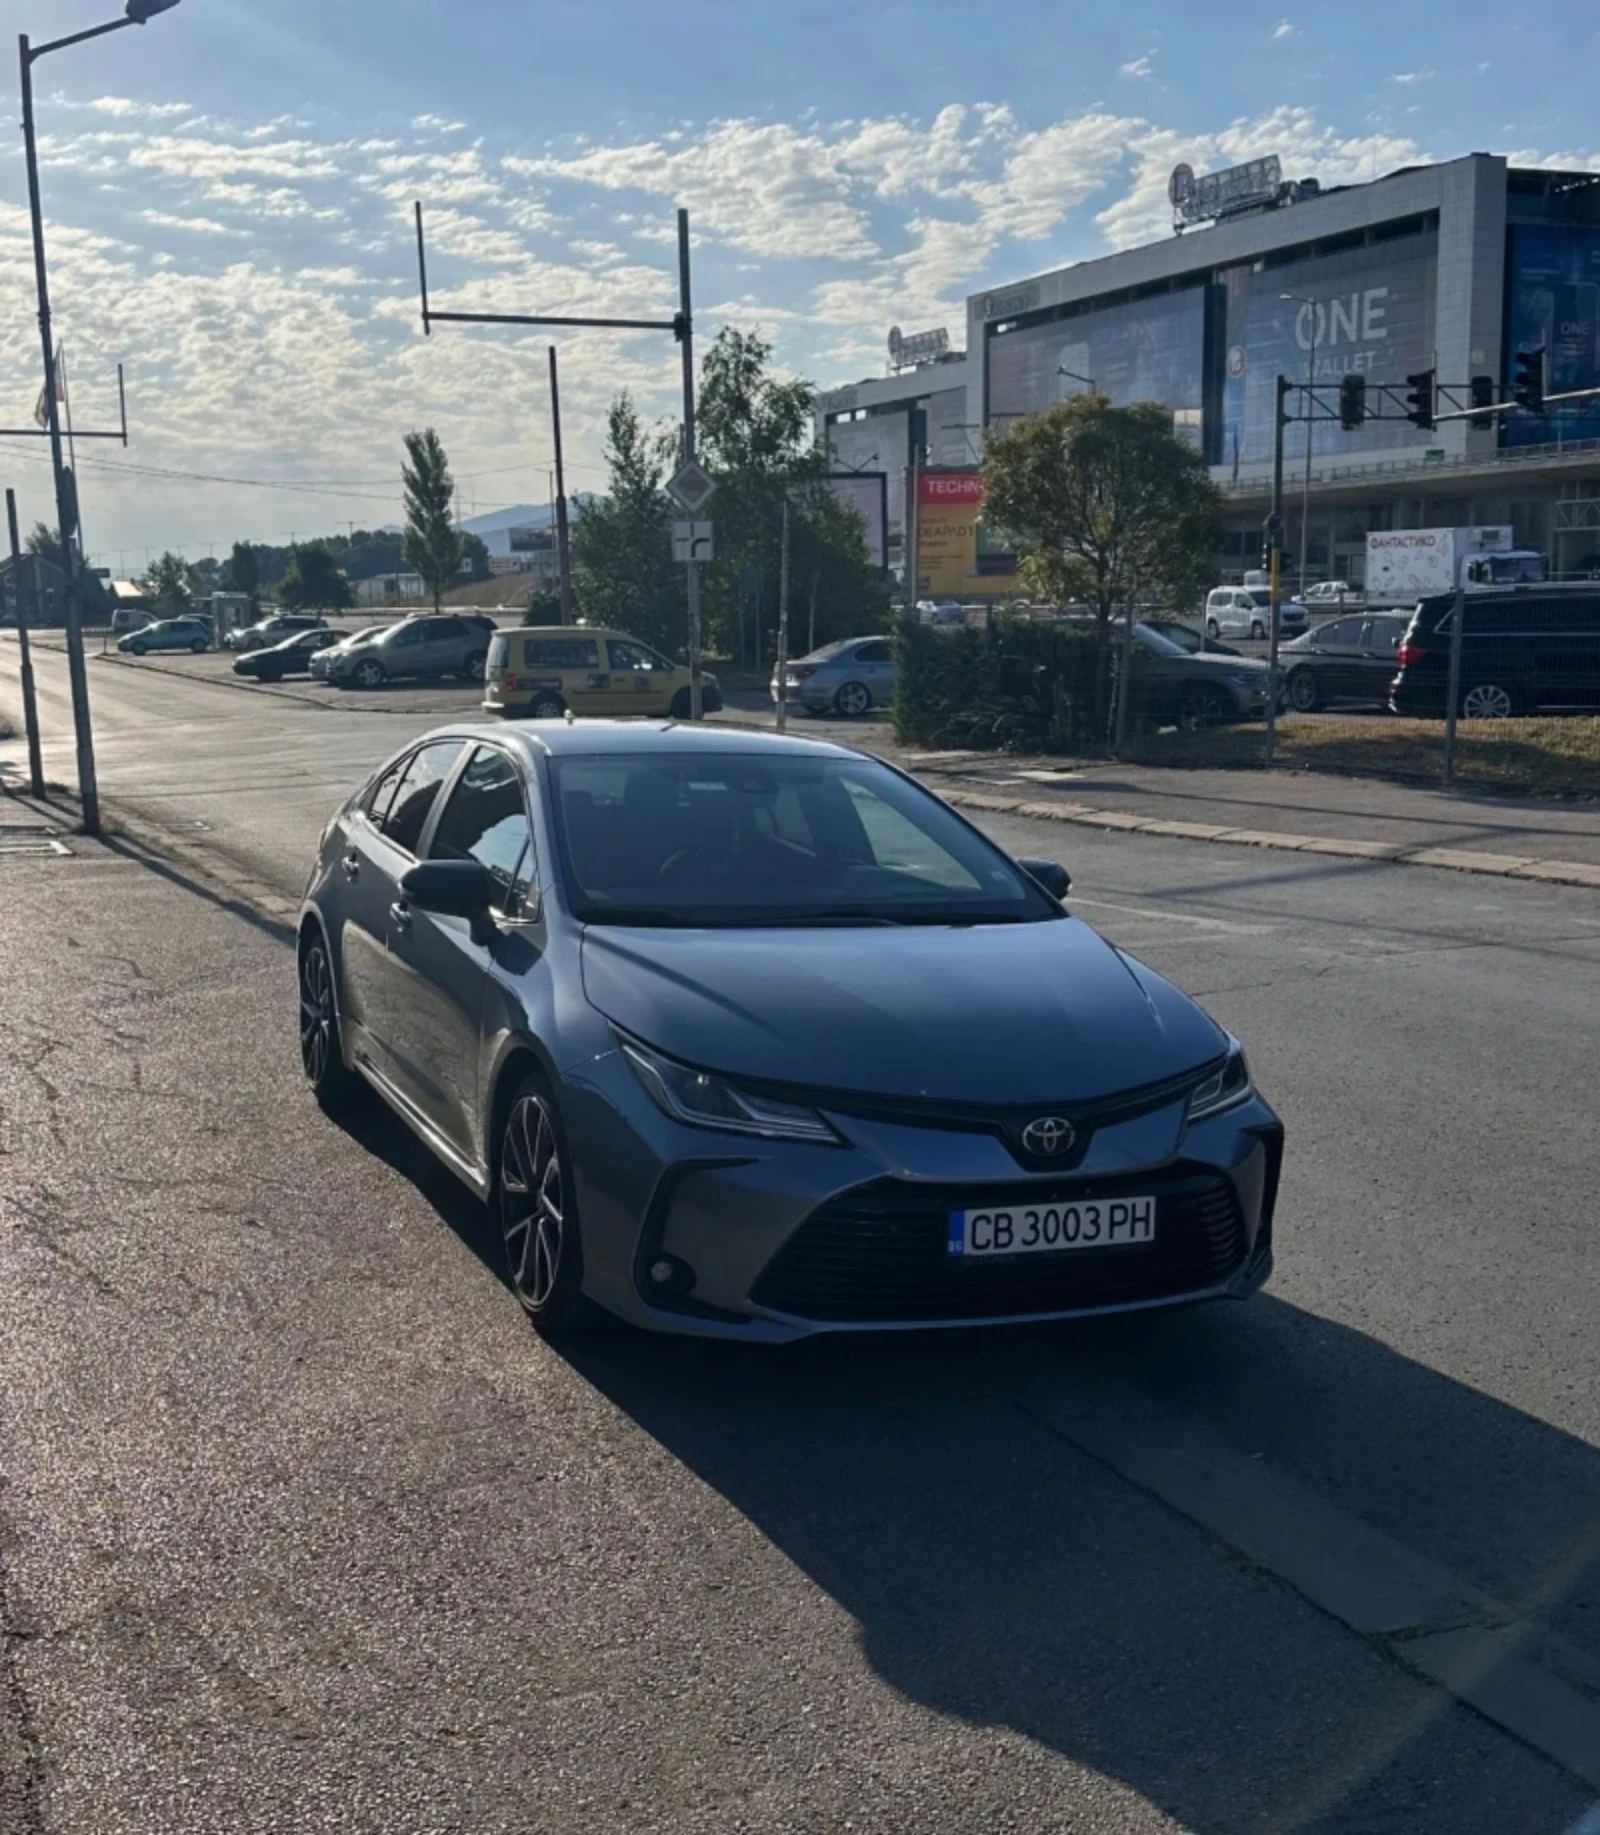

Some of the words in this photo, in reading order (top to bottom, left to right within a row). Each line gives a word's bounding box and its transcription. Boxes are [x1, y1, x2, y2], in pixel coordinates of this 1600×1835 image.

[1295, 287, 1389, 351] ONE
[1560, 321, 1589, 335] ONE
[1303, 350, 1376, 378] WALLET
[1370, 535, 1437, 549] ФАНТАСТИКО
[971, 1212, 1014, 1250] CB
[1021, 1205, 1101, 1247] 3003
[1108, 1201, 1151, 1240] PH
